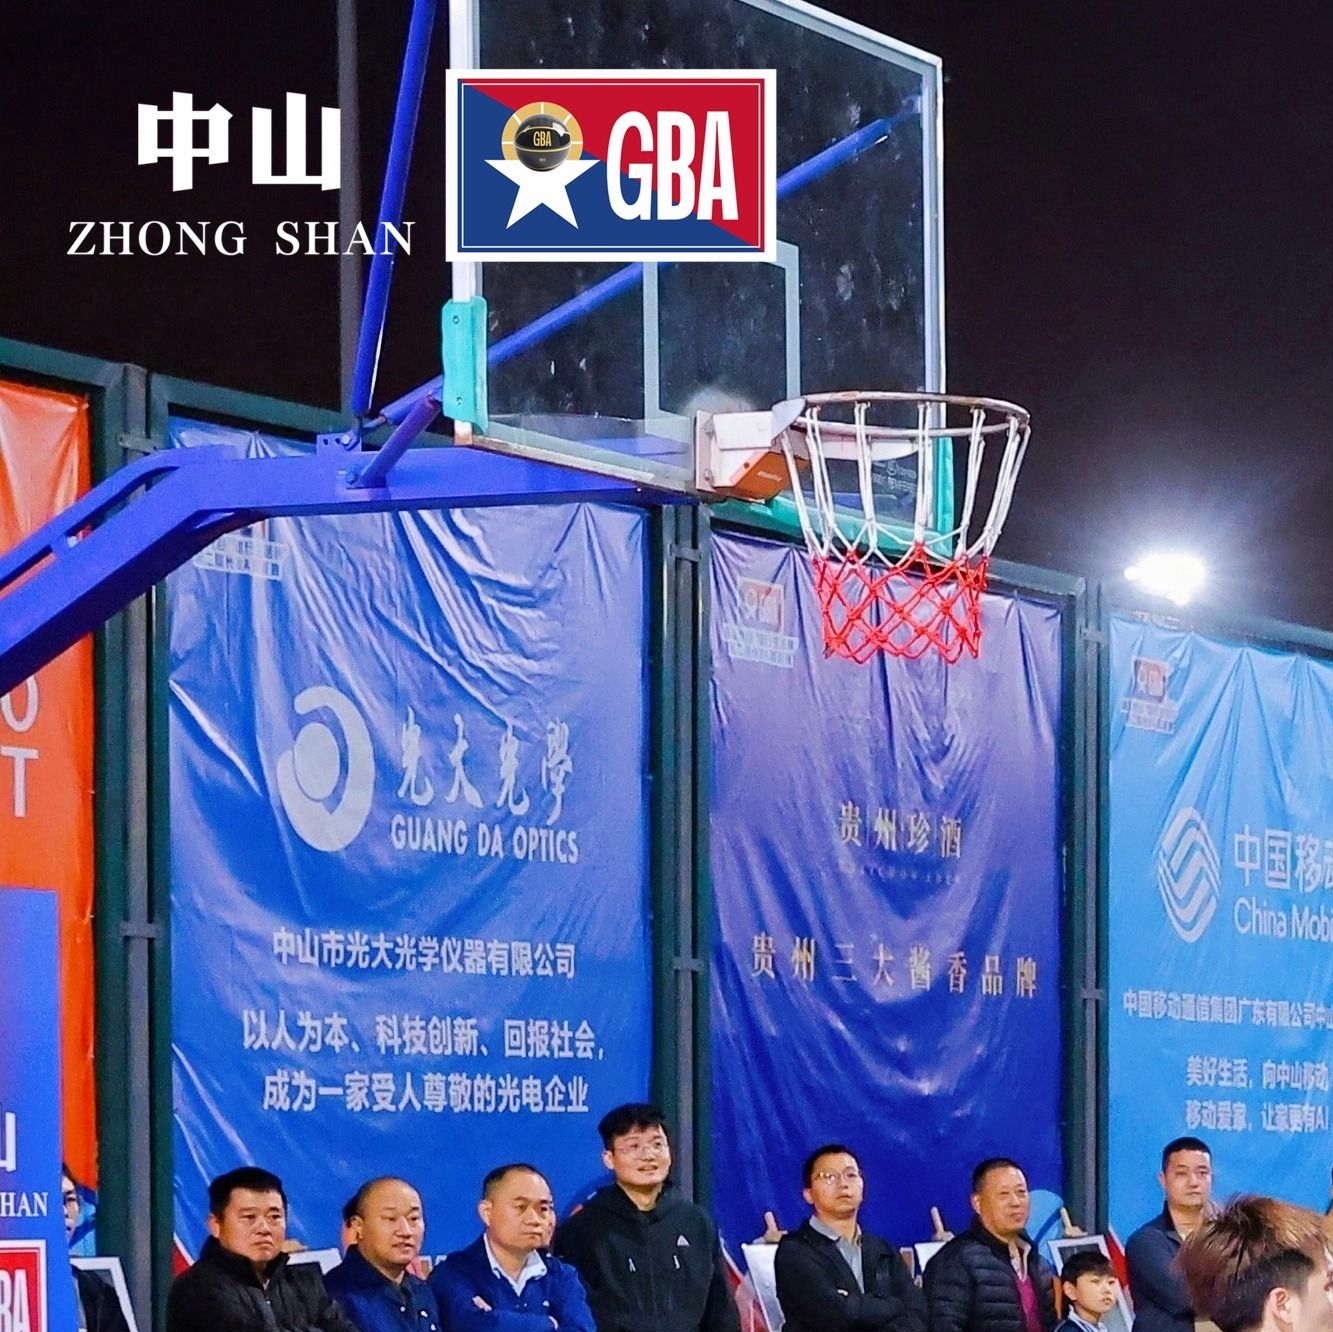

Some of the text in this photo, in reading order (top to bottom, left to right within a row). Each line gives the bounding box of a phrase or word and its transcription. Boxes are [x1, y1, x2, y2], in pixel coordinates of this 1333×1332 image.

[391, 813, 579, 864] GUANG DA OPTICS
[839, 801, 962, 859] 贵州珍酒
[1234, 896, 1288, 938] China
[272, 926, 576, 979] 中山市光大光学仪器有限公司
[751, 932, 1038, 999] 贵州三大酱香品牌
[263, 1069, 589, 1113] 成为一家受人尊敬的光电企业
